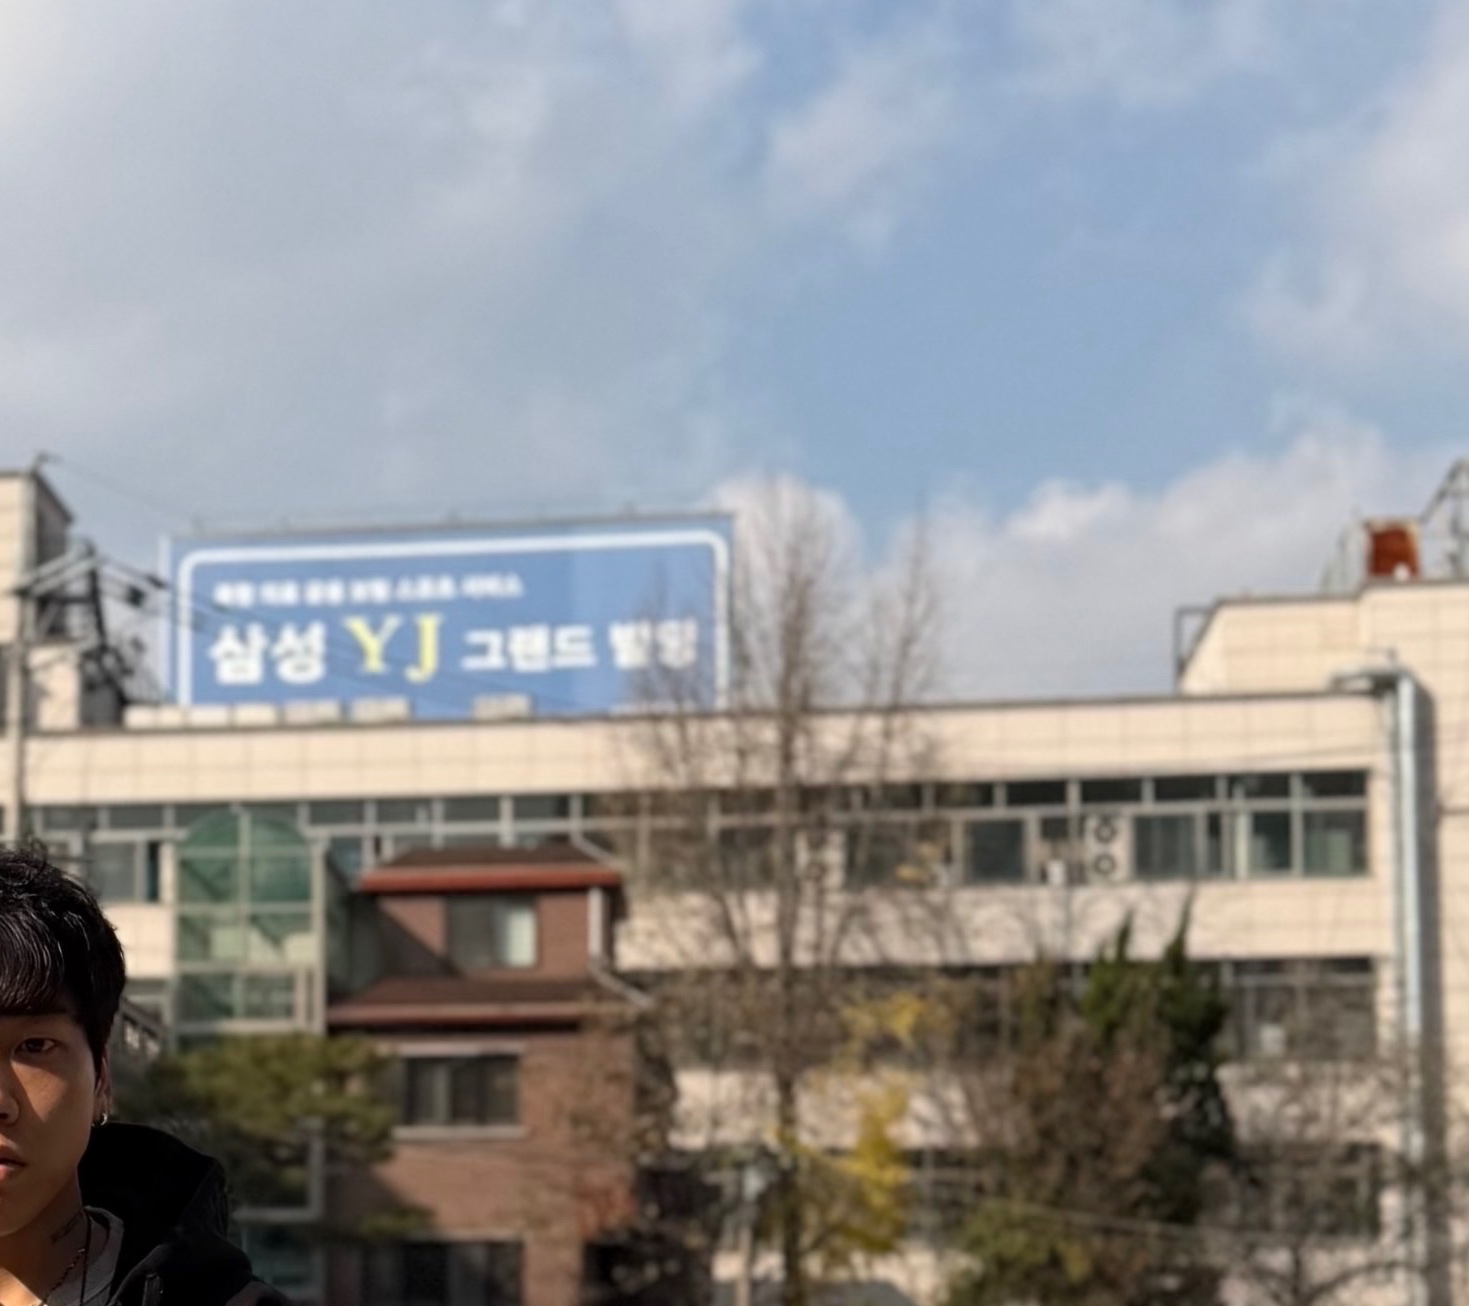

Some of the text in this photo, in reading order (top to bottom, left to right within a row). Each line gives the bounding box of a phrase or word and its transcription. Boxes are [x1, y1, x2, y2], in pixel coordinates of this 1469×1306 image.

[208, 620, 328, 686] 삼성
[342, 612, 444, 683] YJ
[461, 624, 598, 674] 그랜드
